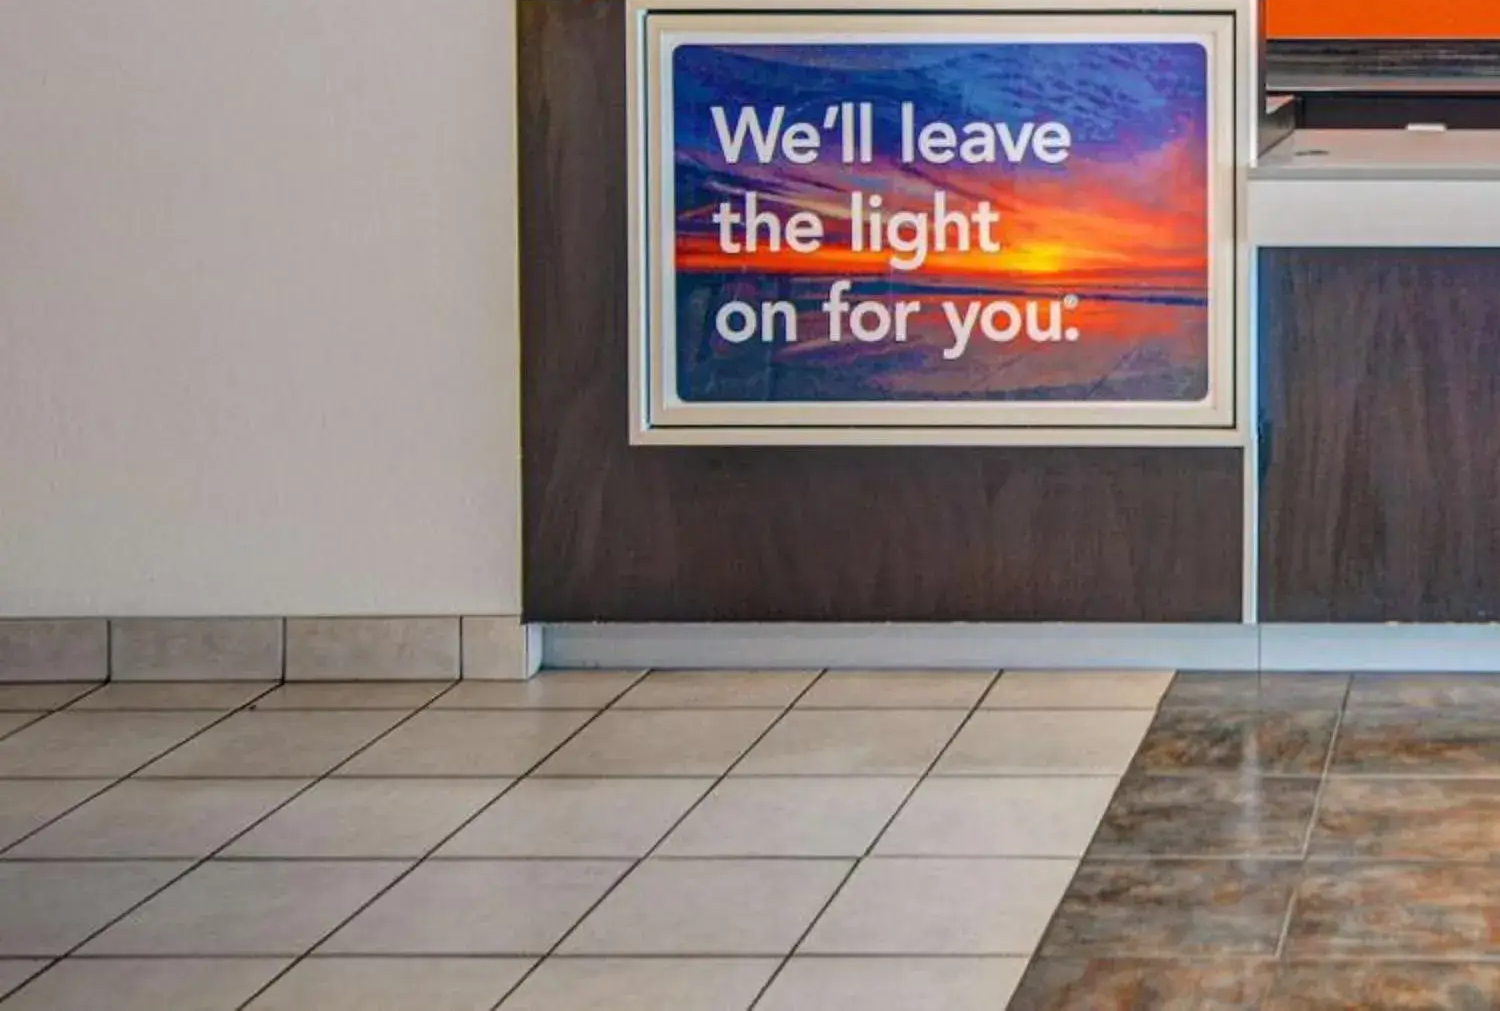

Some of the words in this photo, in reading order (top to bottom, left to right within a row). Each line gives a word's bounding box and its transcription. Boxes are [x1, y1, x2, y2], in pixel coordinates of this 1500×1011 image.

[711, 102, 873, 163] We'll
[901, 102, 1072, 163] leave
[712, 192, 823, 252] the
[851, 191, 1000, 271] light
[715, 300, 797, 343] on
[822, 280, 921, 343] for
